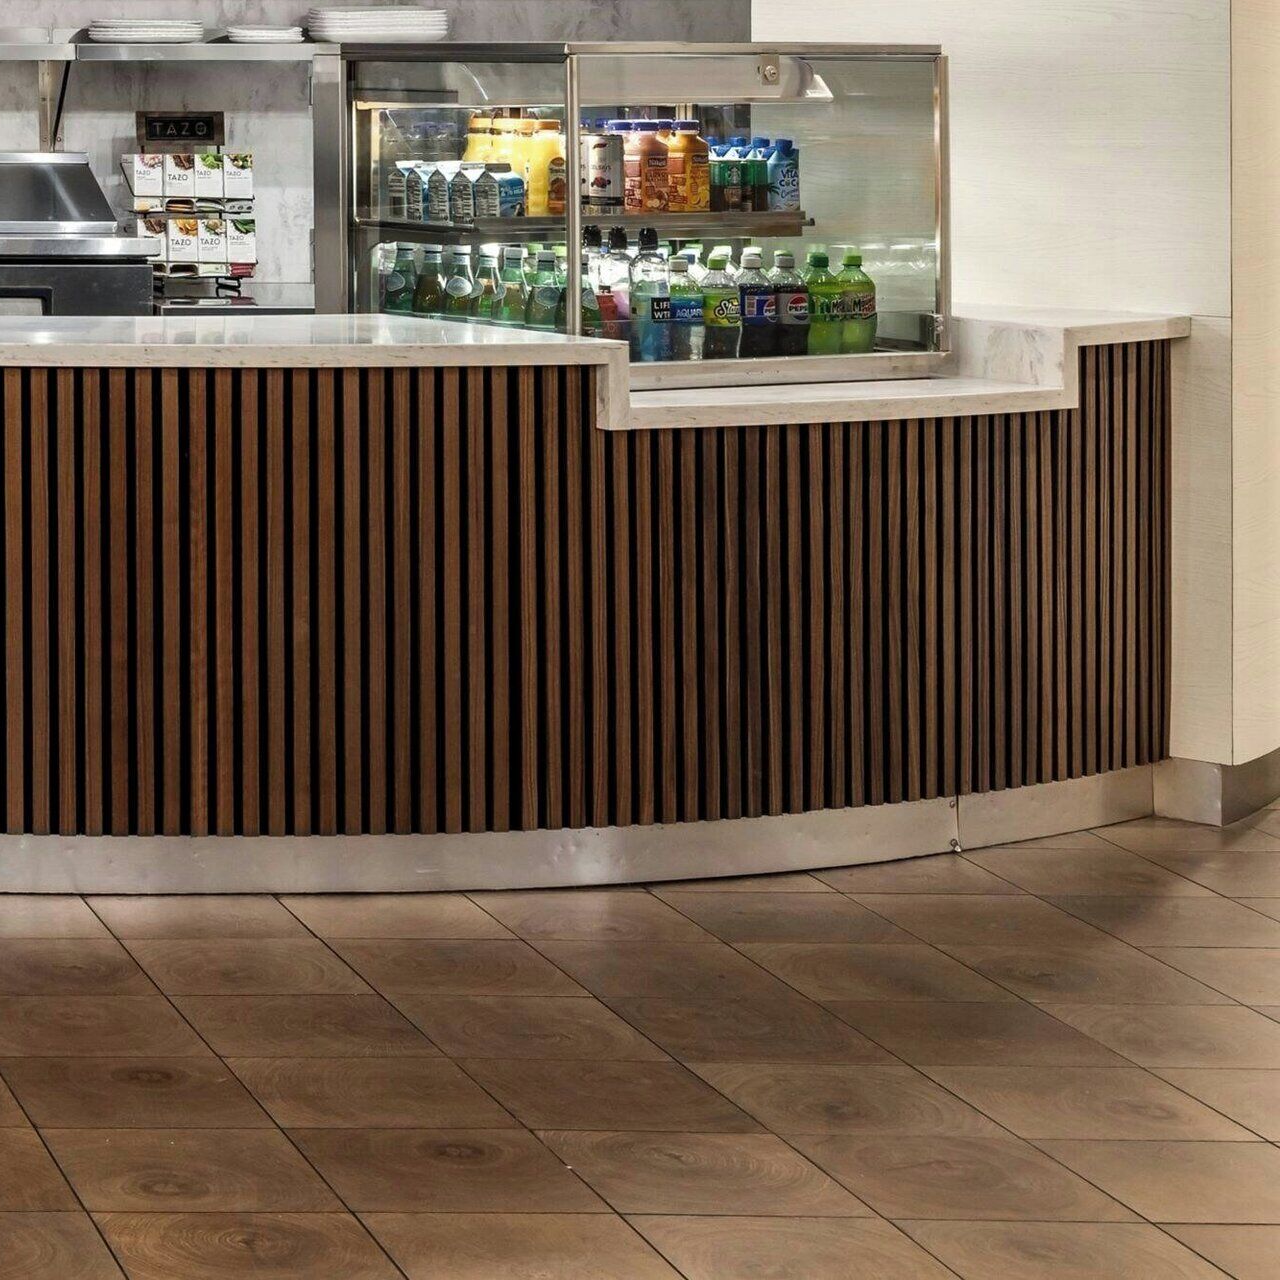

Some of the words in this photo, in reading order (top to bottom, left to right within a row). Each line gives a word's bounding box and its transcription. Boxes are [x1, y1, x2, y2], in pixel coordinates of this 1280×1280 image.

[152, 122, 207, 135] TAZO
[170, 238, 192, 246] TAZO
[200, 238, 220, 246] TAZO
